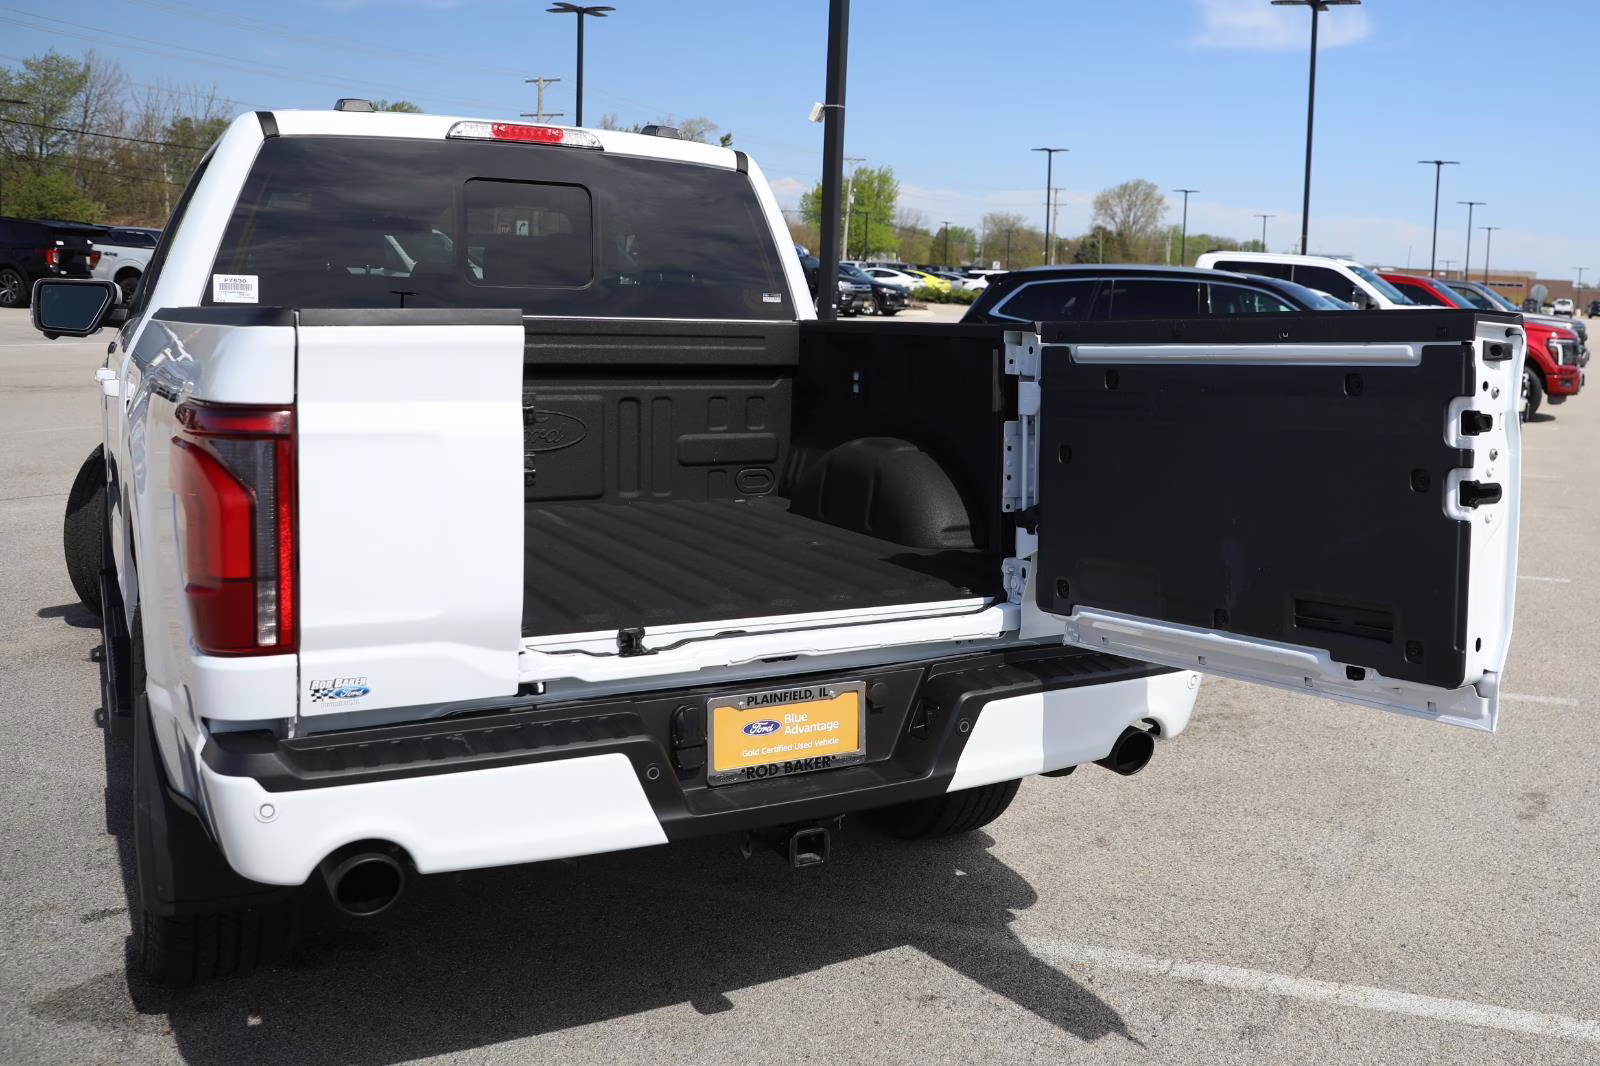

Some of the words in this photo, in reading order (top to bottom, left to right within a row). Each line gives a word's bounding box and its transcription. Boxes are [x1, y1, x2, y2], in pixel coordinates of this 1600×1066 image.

[747, 689, 815, 706] PLAINFIELD,
[819, 687, 829, 697] IL
[784, 713, 808, 724] Blue
[750, 722, 774, 734] Ford
[784, 720, 840, 735] Advantage
[742, 748, 759, 758] Gold
[762, 744, 793, 755] Certified
[795, 741, 813, 750] Used
[815, 737, 840, 747] Vehicle
